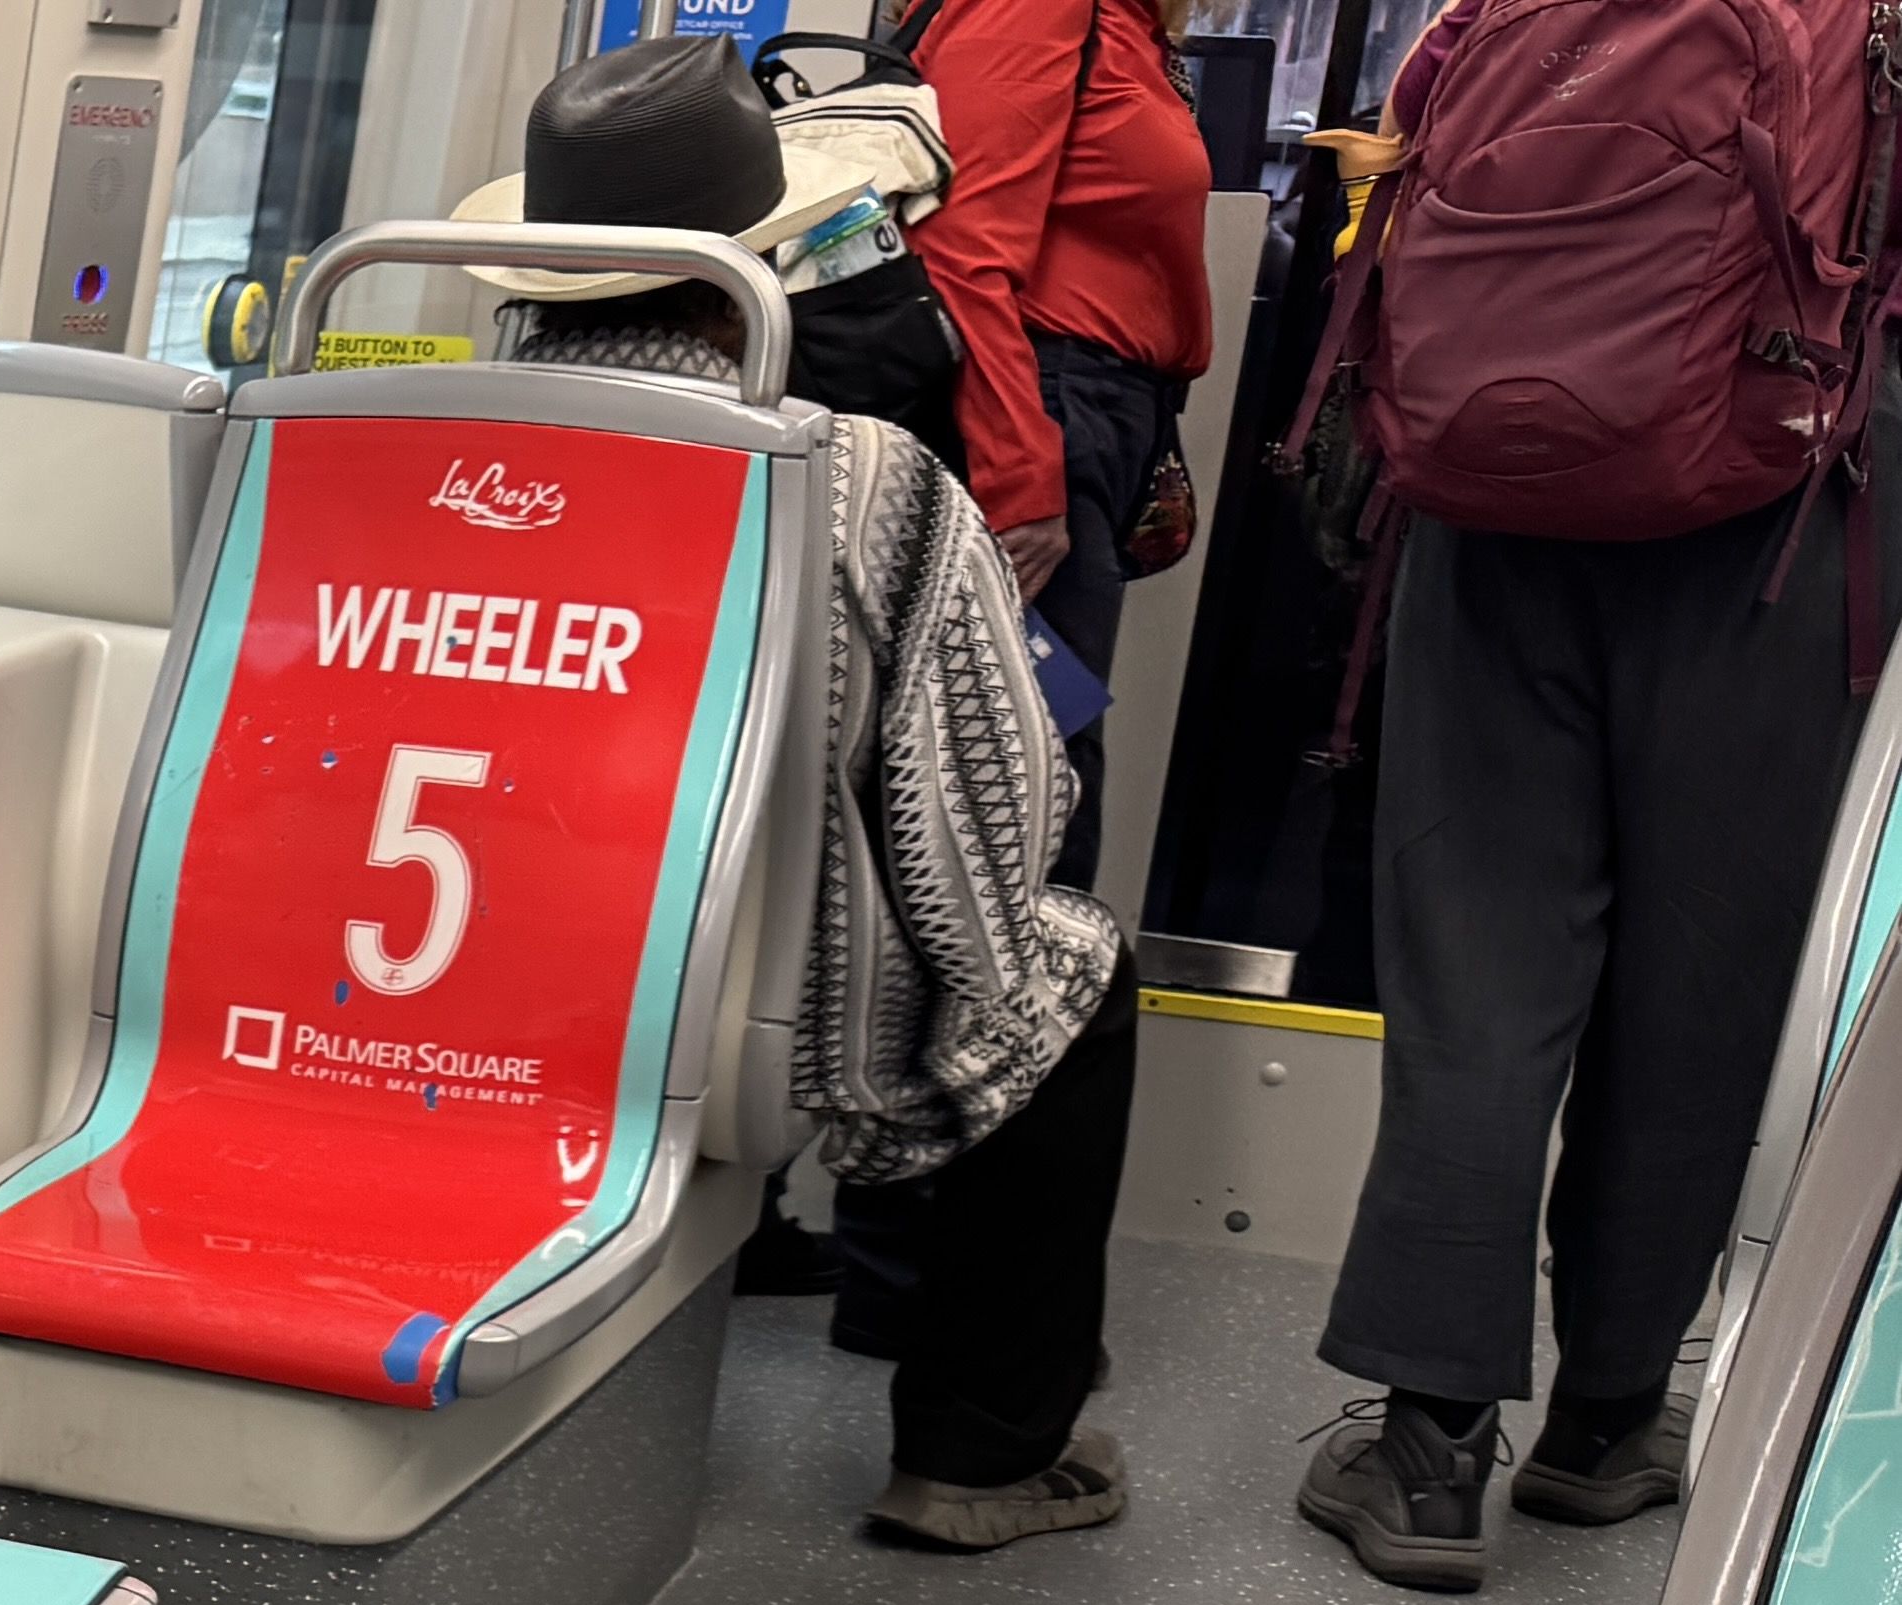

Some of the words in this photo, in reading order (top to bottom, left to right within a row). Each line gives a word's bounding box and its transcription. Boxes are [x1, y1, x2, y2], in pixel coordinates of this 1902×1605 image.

[69, 104, 155, 128] EMERGENC
[334, 337, 408, 356] BUTTON
[412, 341, 436, 357] TO
[314, 356, 371, 372] QUEST
[317, 583, 643, 695] WHEELER
[344, 743, 494, 997] 5
[290, 1063, 375, 1088] CAPITAL
